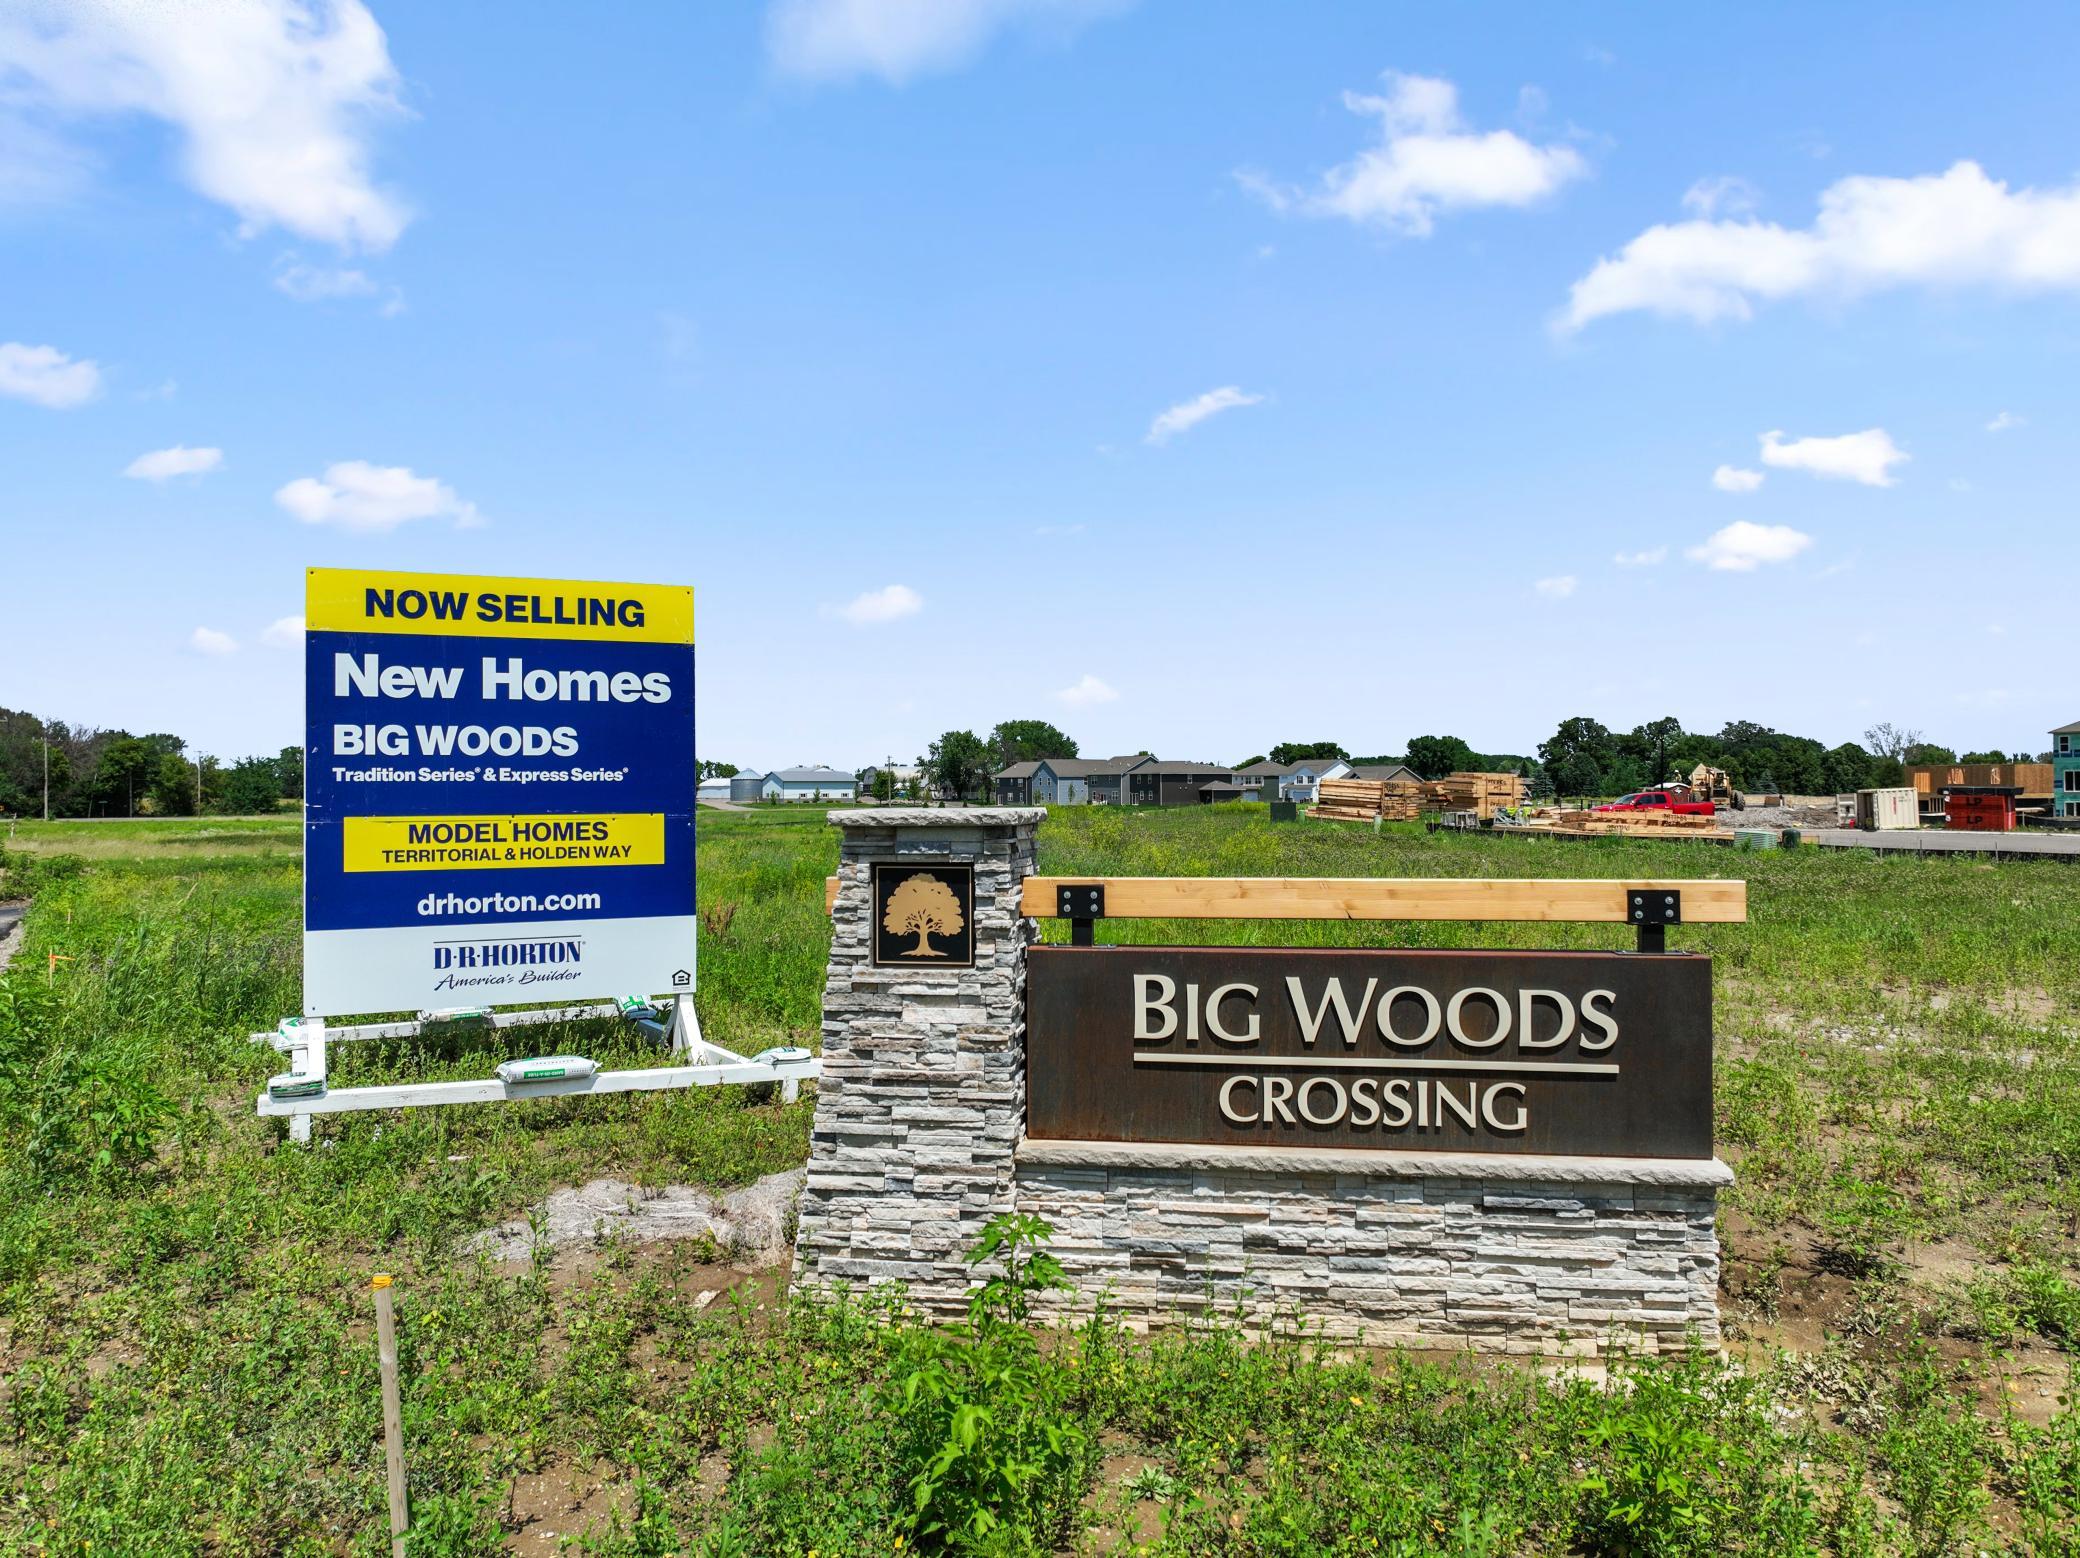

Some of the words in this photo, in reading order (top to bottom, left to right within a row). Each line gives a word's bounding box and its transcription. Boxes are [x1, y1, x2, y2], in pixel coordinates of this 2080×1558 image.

[365, 588, 469, 620] NOW
[476, 594, 645, 627] SELLING
[334, 652, 464, 698] New
[482, 656, 672, 704] Homes
[333, 724, 409, 756] BIG
[415, 725, 579, 757] WOODS
[332, 767, 416, 782] Tradition
[483, 767, 497, 782] &
[499, 767, 569, 785] Express
[408, 823, 508, 844] MODEL
[512, 821, 609, 843] HOMES
[382, 848, 501, 863] TERRITORIAL
[504, 847, 516, 861] &
[519, 846, 591, 861] HOLDEN
[593, 845, 632, 858] WAY
[417, 892, 601, 916] drhorton.com
[433, 973, 515, 991] America's
[518, 968, 582, 986] Builder
[1133, 974, 1261, 1042] BIG
[1285, 977, 1620, 1051] WOODS
[1218, 1075, 1528, 1131] CROSSING
